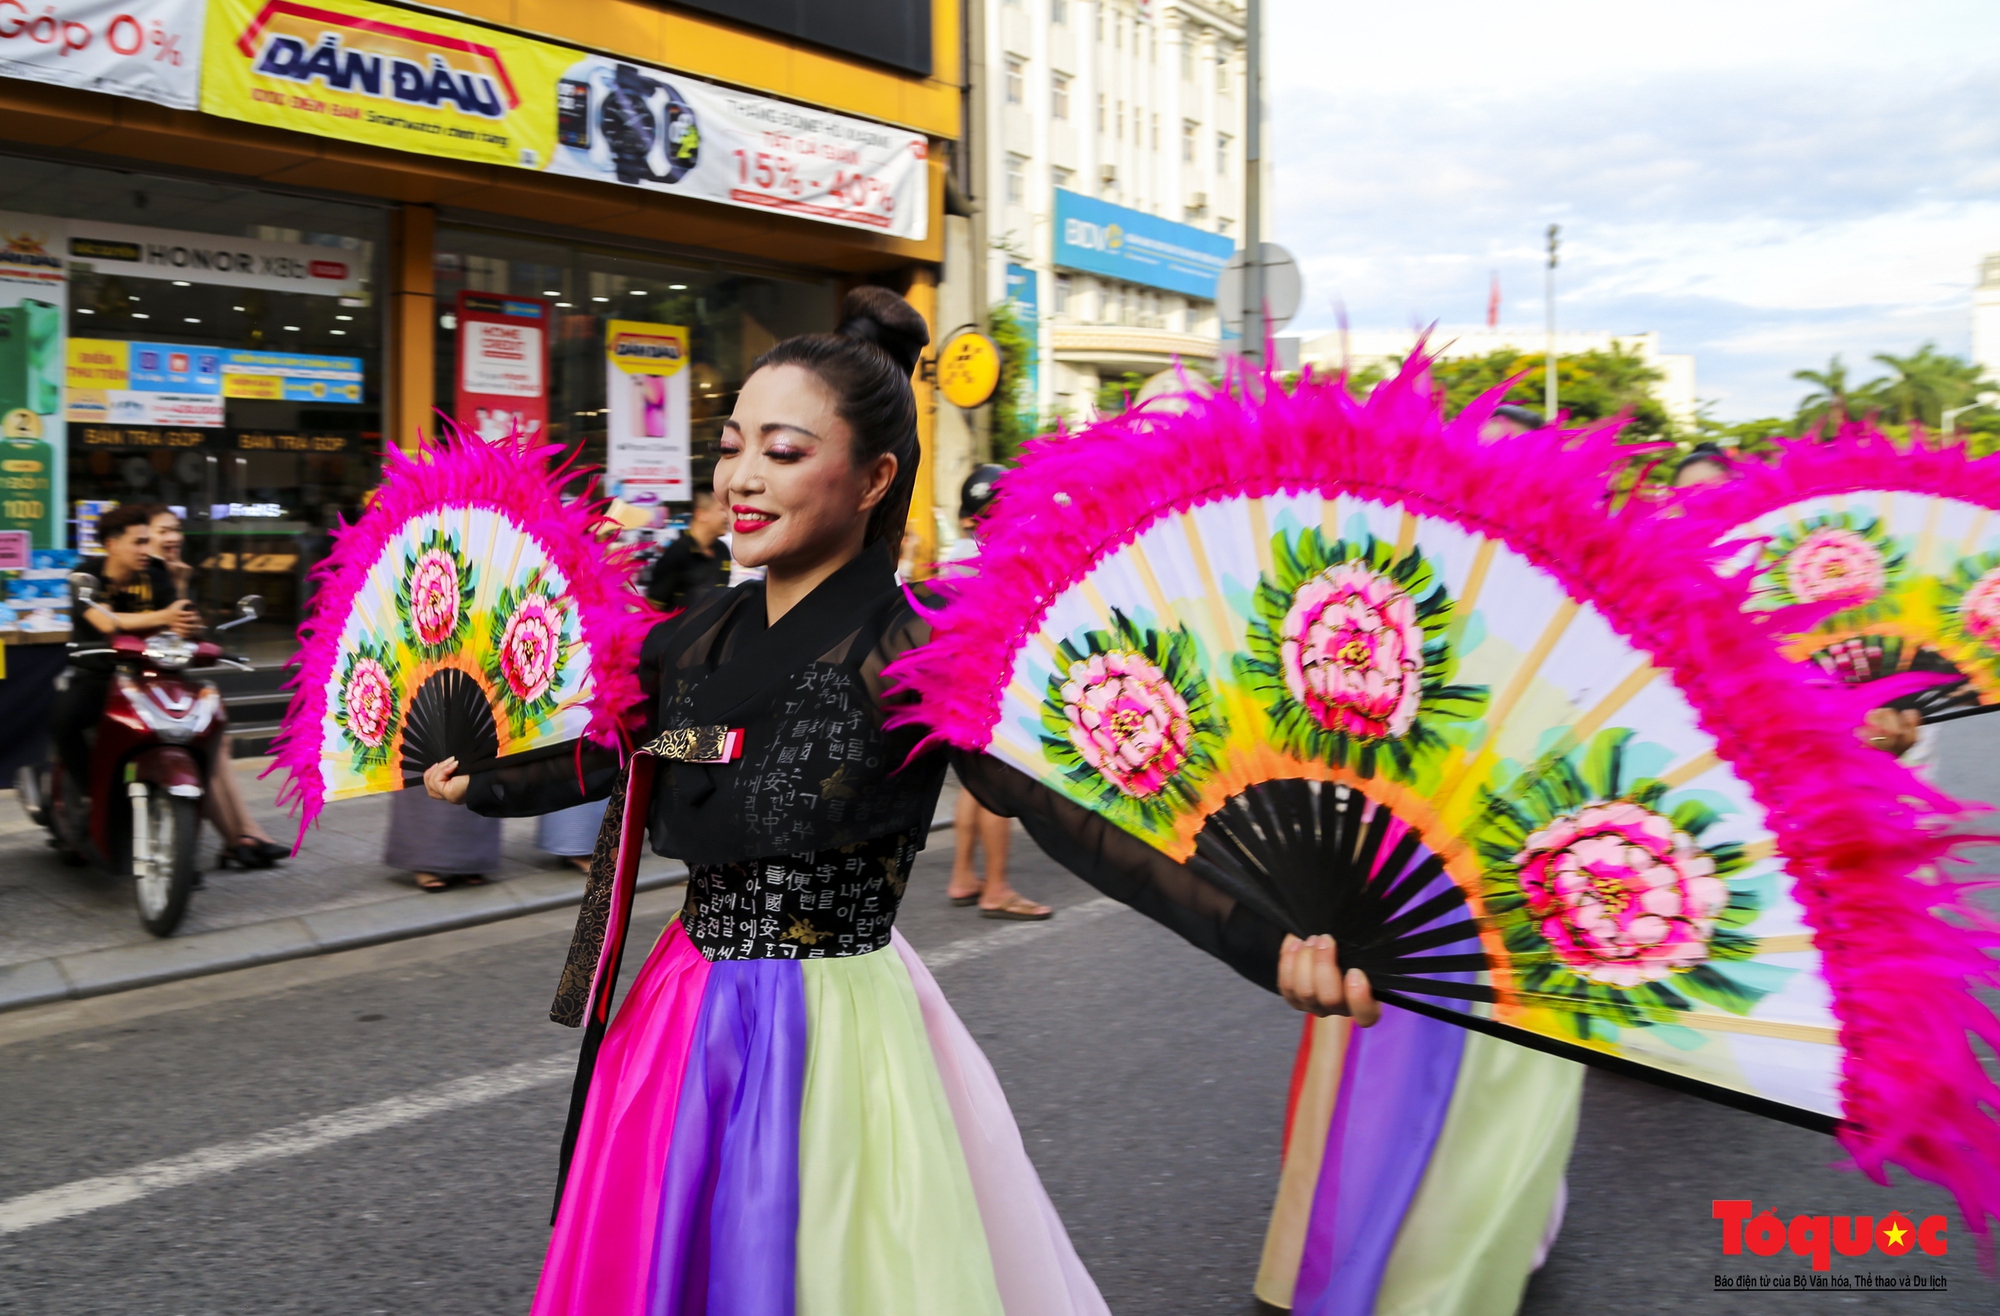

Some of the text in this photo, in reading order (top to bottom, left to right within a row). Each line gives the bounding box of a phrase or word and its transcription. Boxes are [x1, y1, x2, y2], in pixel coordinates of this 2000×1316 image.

[256, 33, 504, 118] DẪN ĐẦU
[733, 149, 804, 195] 15%
[147, 245, 255, 274] HONOR
